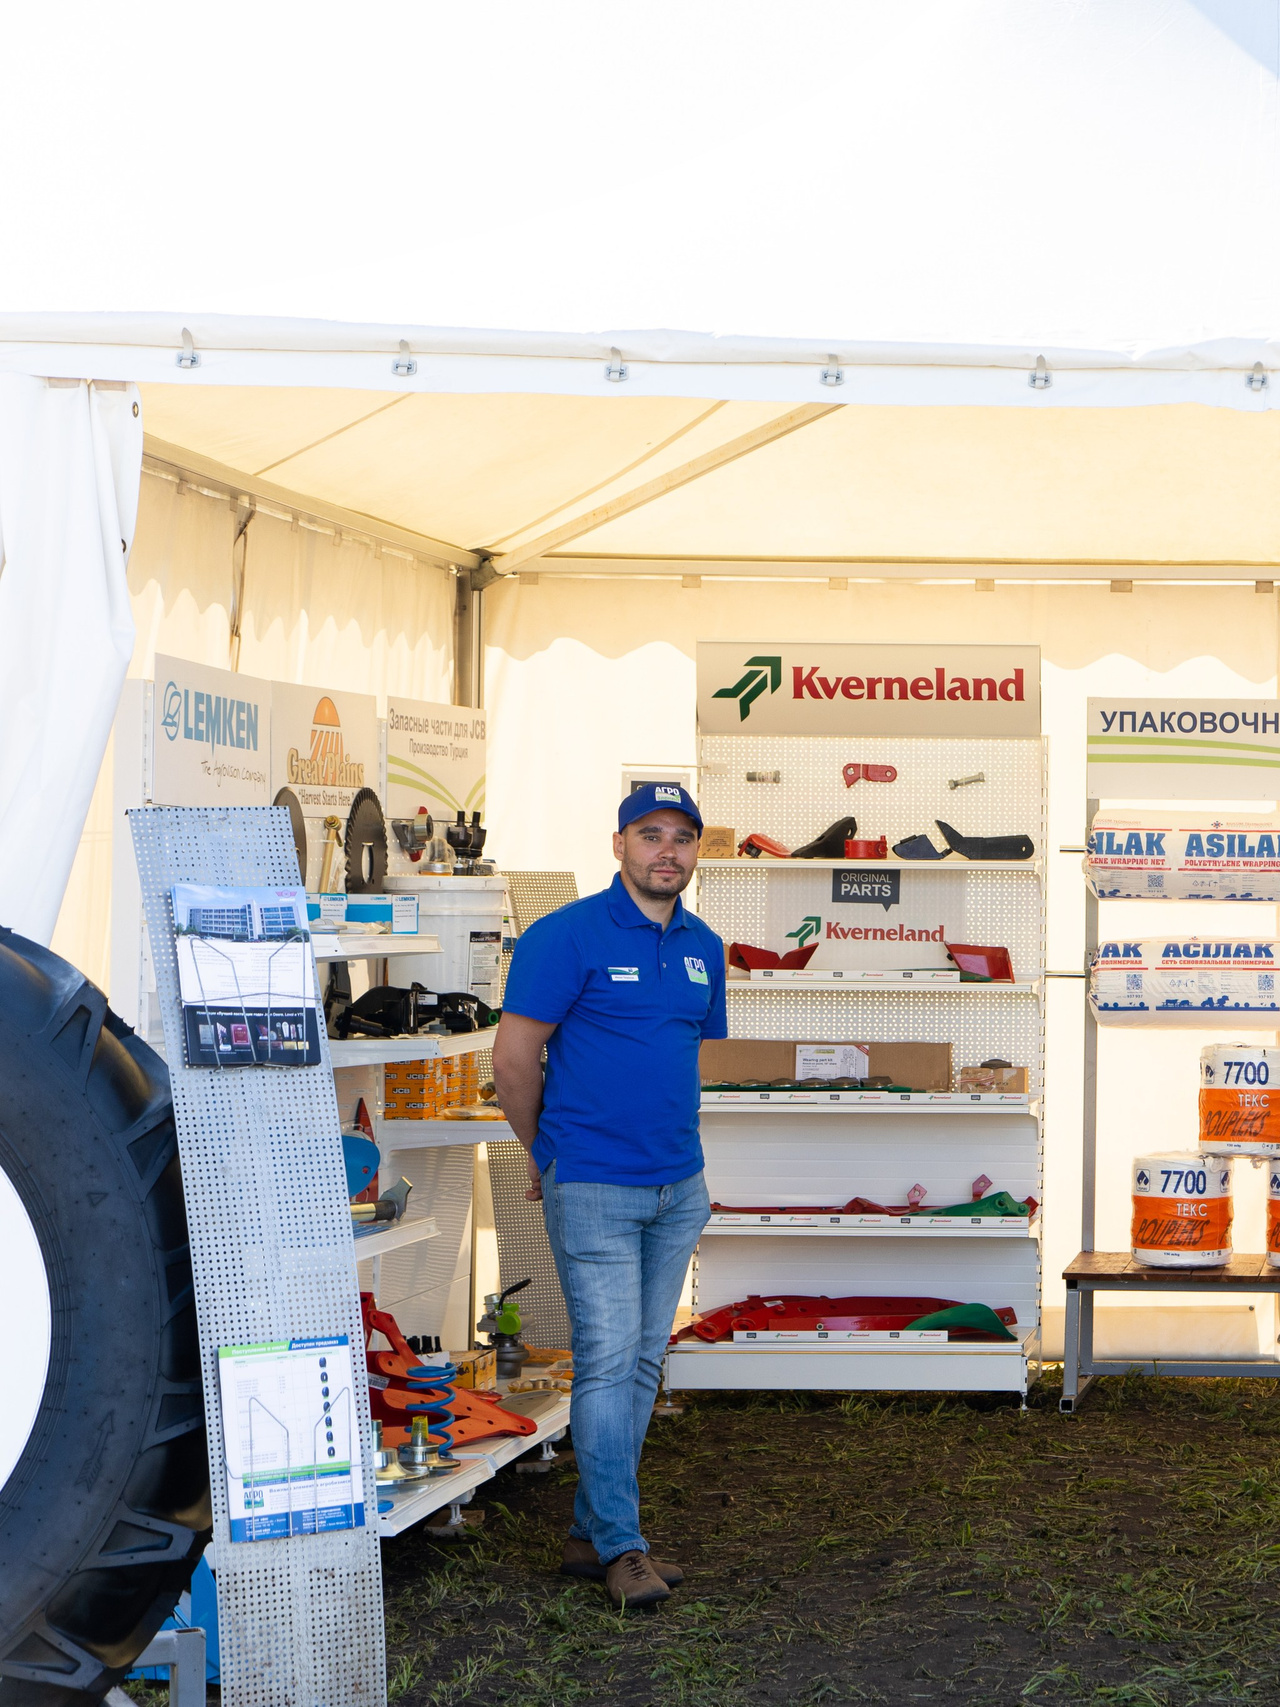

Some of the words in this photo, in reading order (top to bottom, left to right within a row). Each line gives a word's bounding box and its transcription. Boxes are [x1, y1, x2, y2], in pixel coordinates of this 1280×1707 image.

[791, 666, 1026, 702] Kverneland
[184, 689, 259, 756] LEMKEN
[389, 708, 429, 734] Запасные
[431, 719, 453, 737] части
[454, 722, 468, 741] для
[469, 719, 486, 740] JCB
[409, 738, 448, 757] Производство
[449, 742, 469, 761] Турция
[201, 760, 212, 776] The
[241, 766, 267, 793] Company
[286, 747, 325, 785] Great
[326, 752, 365, 788] Plains
[322, 791, 338, 806] Starts
[655, 786, 680, 796] АГРО
[1094, 831, 1166, 856] ILAK
[1110, 858, 1149, 866] WRAPPING
[1150, 858, 1166, 866] NET
[1184, 859, 1240, 867] POLYETHYLENE
[1242, 860, 1280, 868] WRAPPING
[840, 872, 892, 883] ORIGINAL
[841, 883, 892, 897] PARTS
[825, 921, 945, 942] Kverneland
[684, 956, 705, 972] АГРО
[1223, 1061, 1269, 1085] 7700
[1238, 1094, 1270, 1108] ТЕКС
[1205, 1110, 1271, 1137] POLIPLEKS
[1160, 1170, 1207, 1194] 7700
[1176, 1203, 1208, 1217] ТЕКС
[1135, 1218, 1211, 1246] POLIPLEKS
